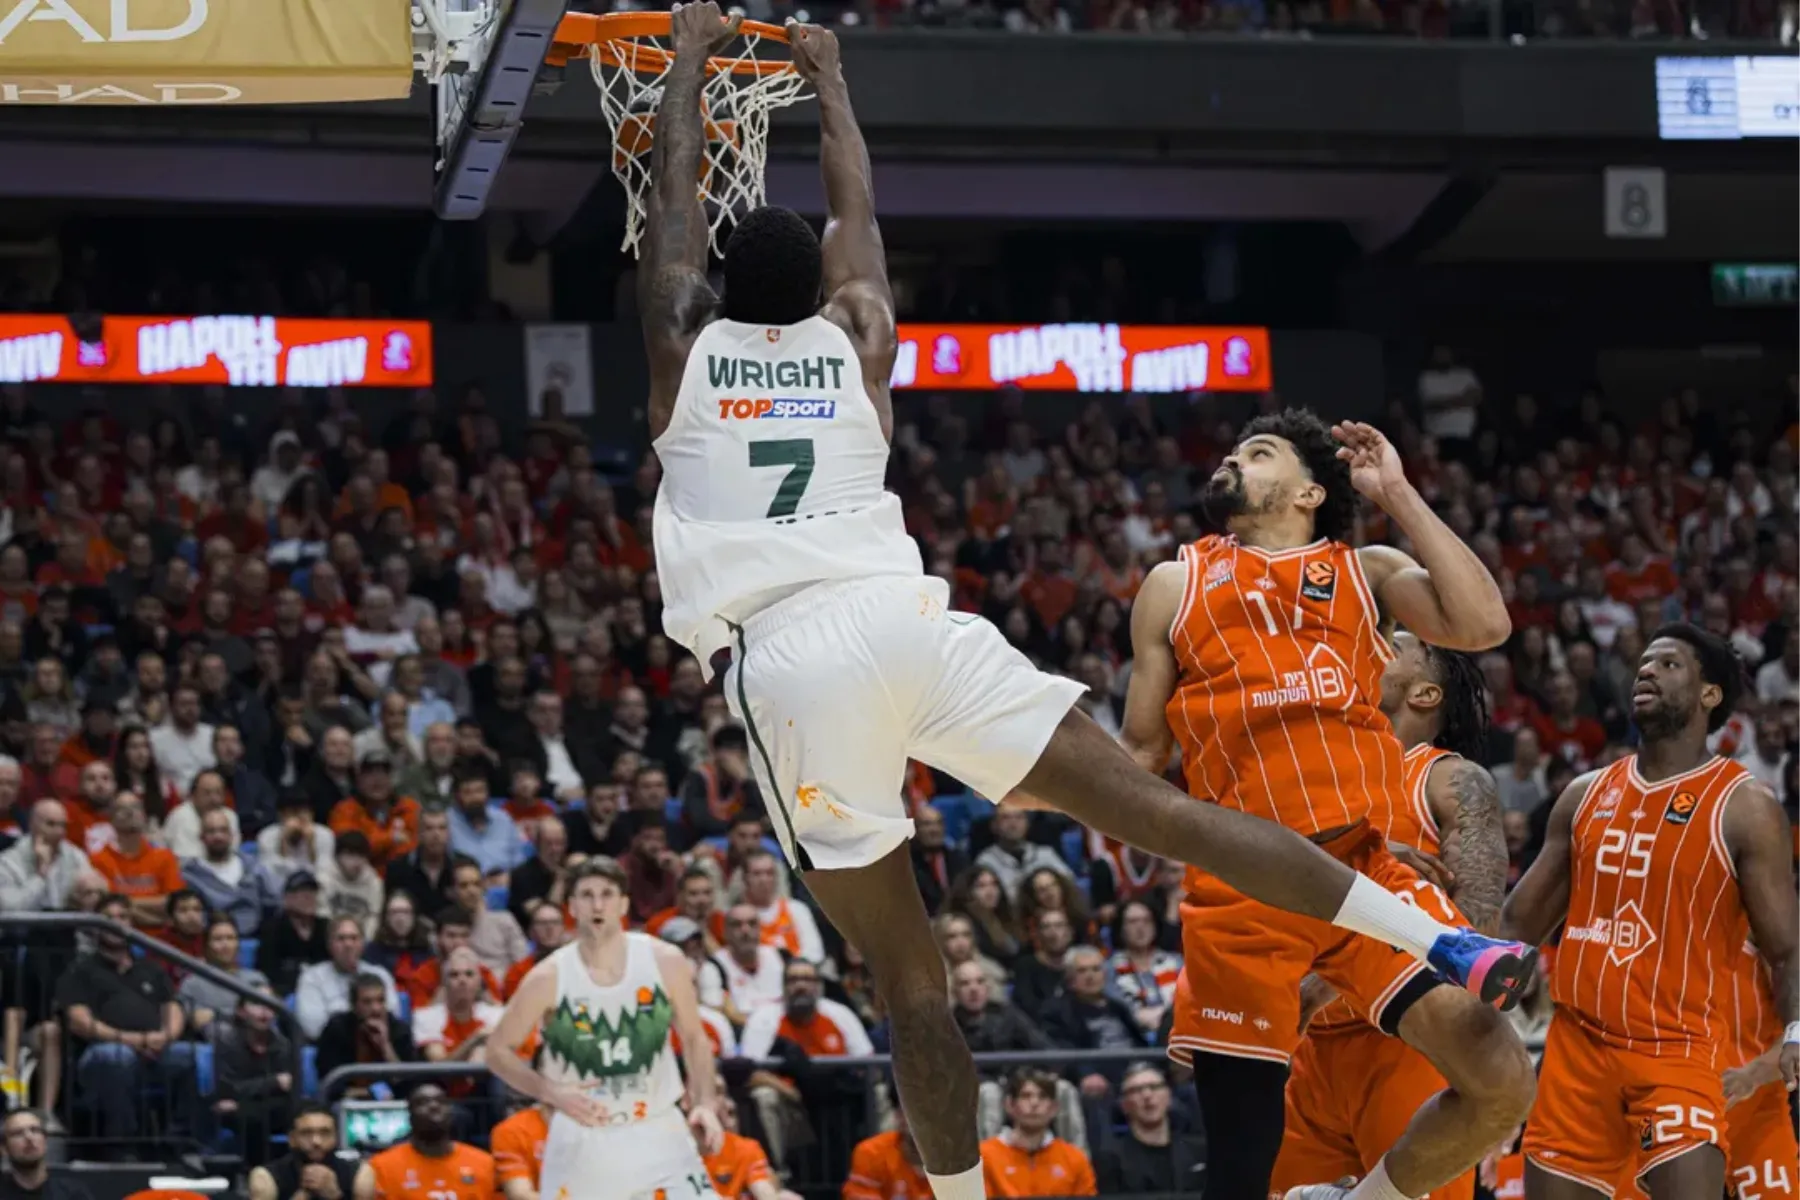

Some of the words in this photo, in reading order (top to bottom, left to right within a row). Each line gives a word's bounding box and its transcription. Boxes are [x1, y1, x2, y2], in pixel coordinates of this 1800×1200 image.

[707, 354, 845, 389] WRIGHT
[718, 398, 834, 419] TOPsport
[748, 438, 815, 518] 7
[1310, 666, 1347, 700] IBI
[1595, 829, 1657, 877] 25
[1612, 921, 1641, 949] IBI
[598, 1037, 633, 1067] 14
[1656, 1104, 1718, 1144] 25
[1733, 1159, 1792, 1200] 24
